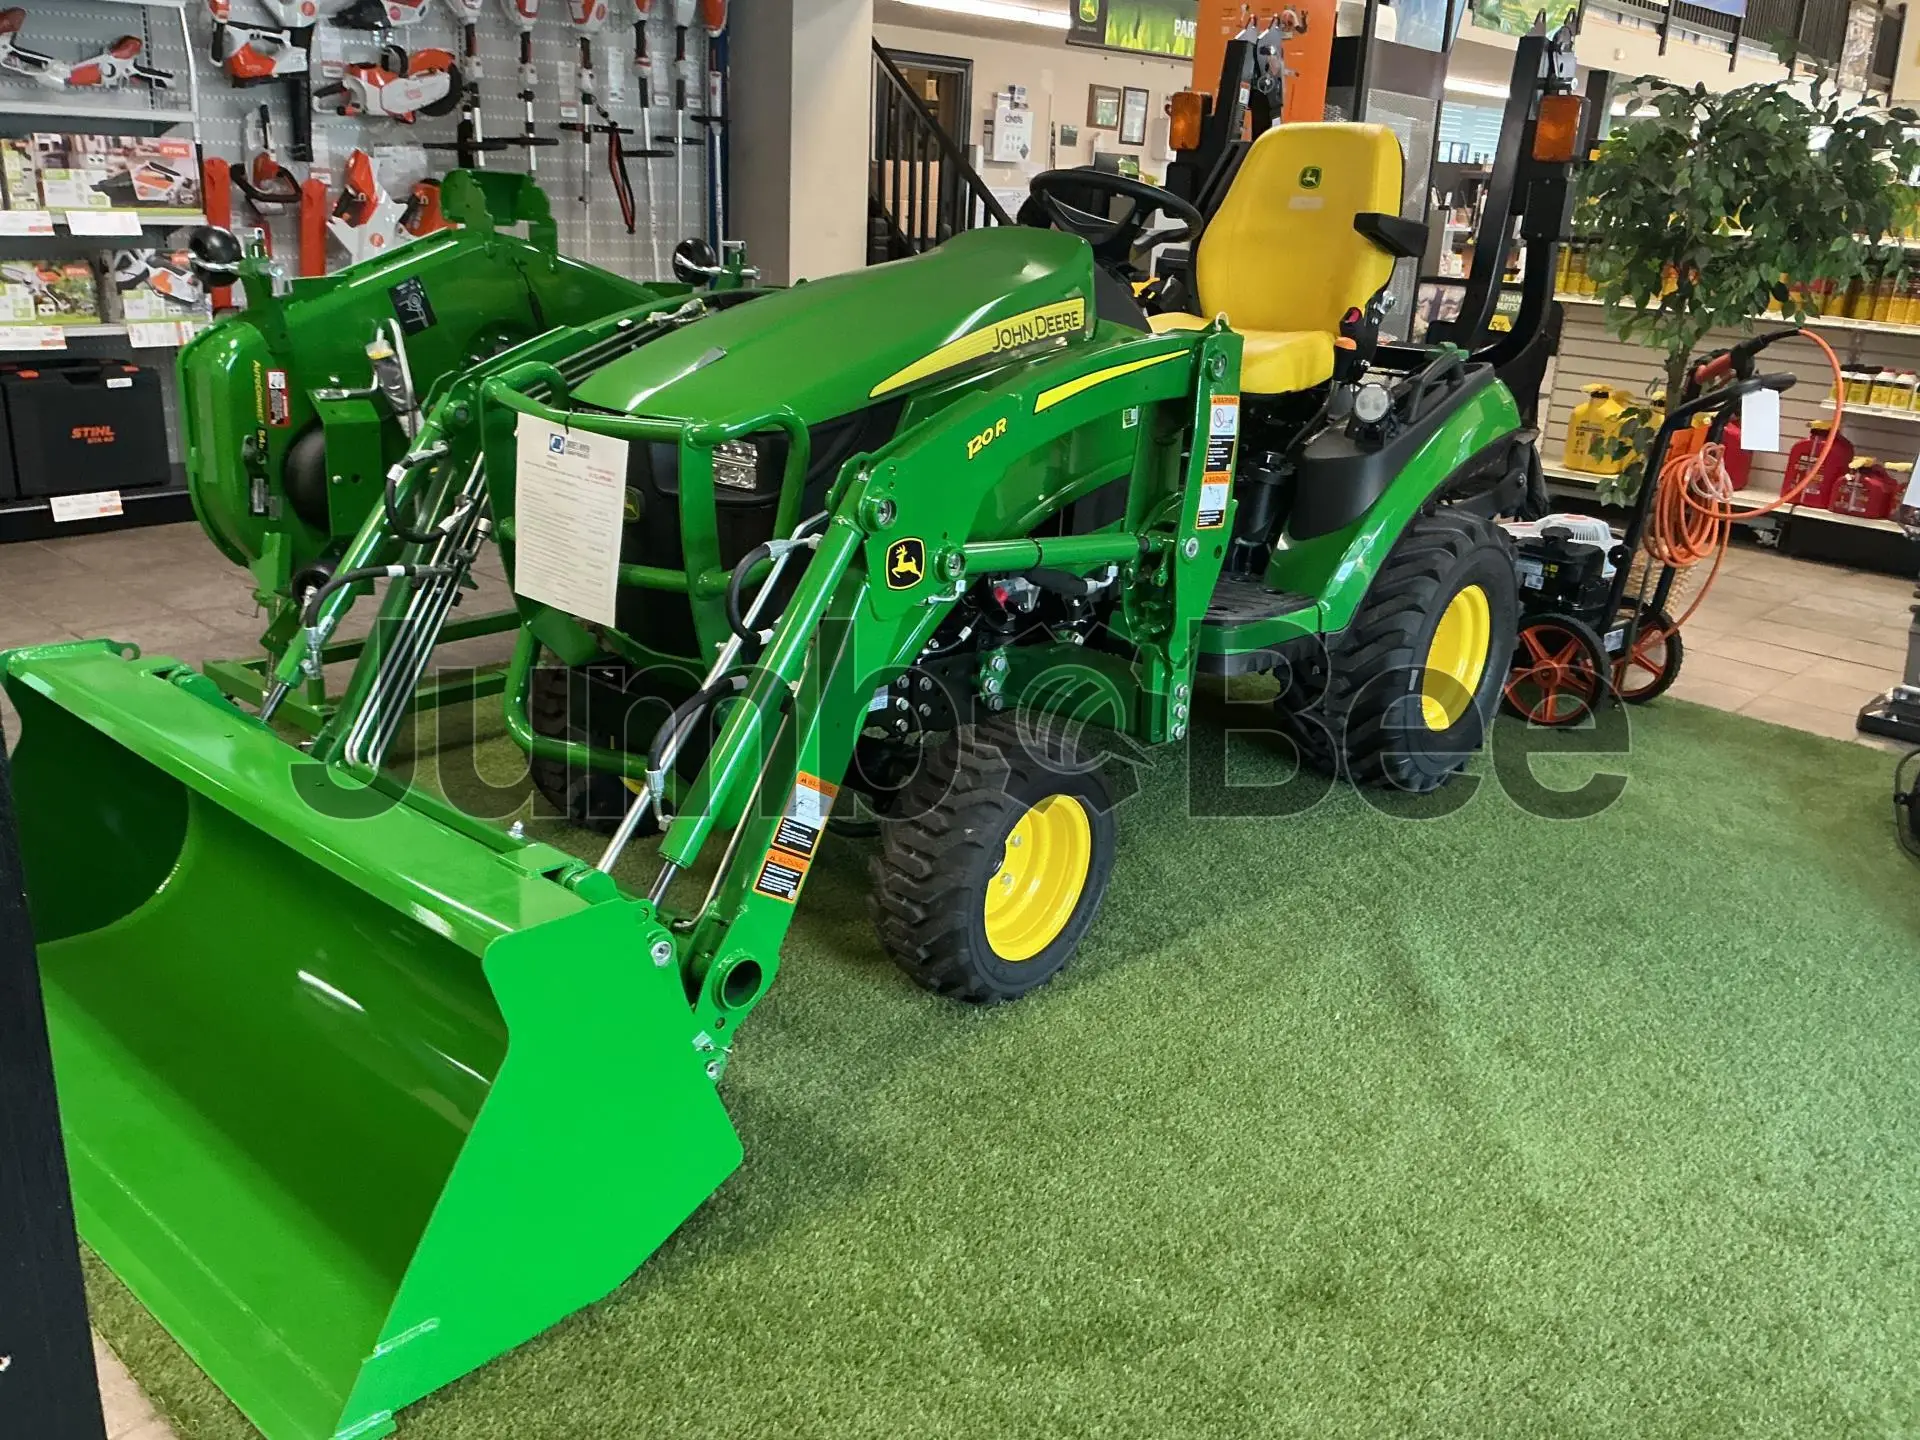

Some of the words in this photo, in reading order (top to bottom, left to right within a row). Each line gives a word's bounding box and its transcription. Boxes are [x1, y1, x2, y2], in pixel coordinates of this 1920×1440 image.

[1174, 19, 1197, 38] PAR
[992, 322, 1034, 351] JOHN
[1034, 310, 1080, 339] DEERE
[71, 426, 115, 439] STIHL
